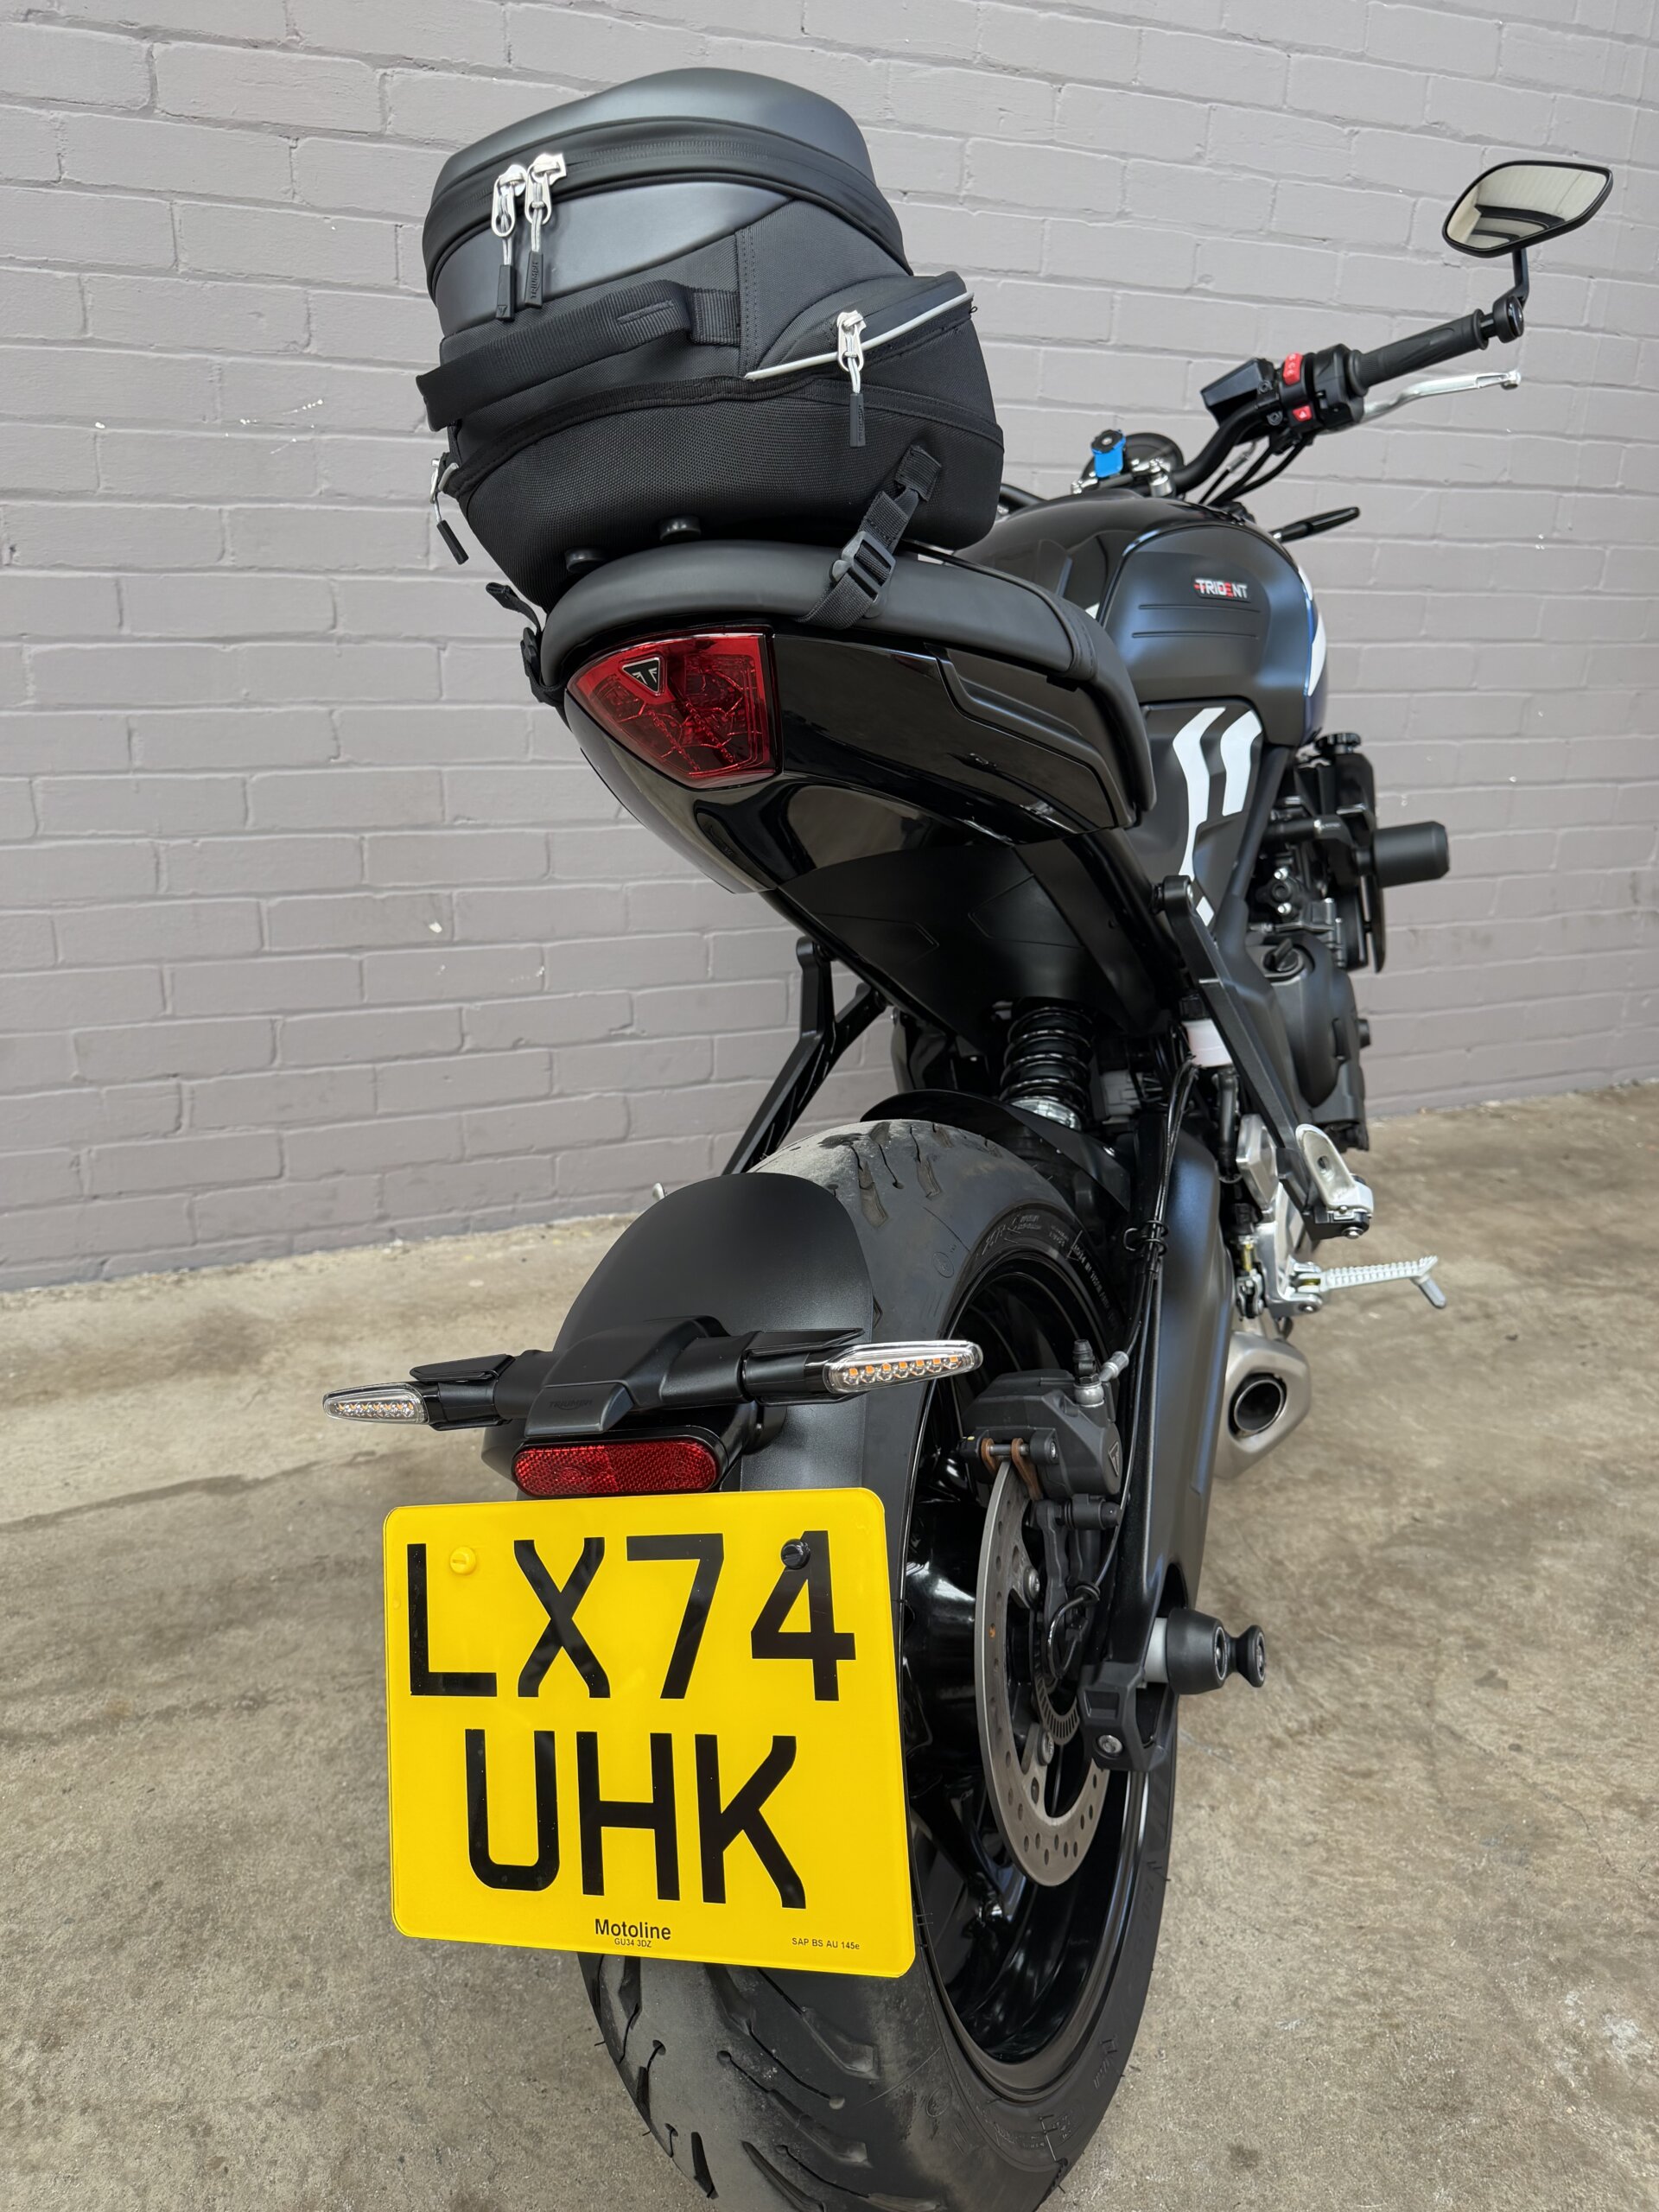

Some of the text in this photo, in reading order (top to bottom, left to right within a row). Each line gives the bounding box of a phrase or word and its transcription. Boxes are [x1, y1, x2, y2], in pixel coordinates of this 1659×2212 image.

[1194, 578, 1248, 599] TRIDENT
[407, 1530, 856, 1701] LX74
[465, 1729, 806, 1910] UHK
[594, 1918, 671, 1941] Motoline
[614, 1937, 652, 1948] GU34 3DZ
[791, 1937, 861, 1950] SAP BS AU 145e
